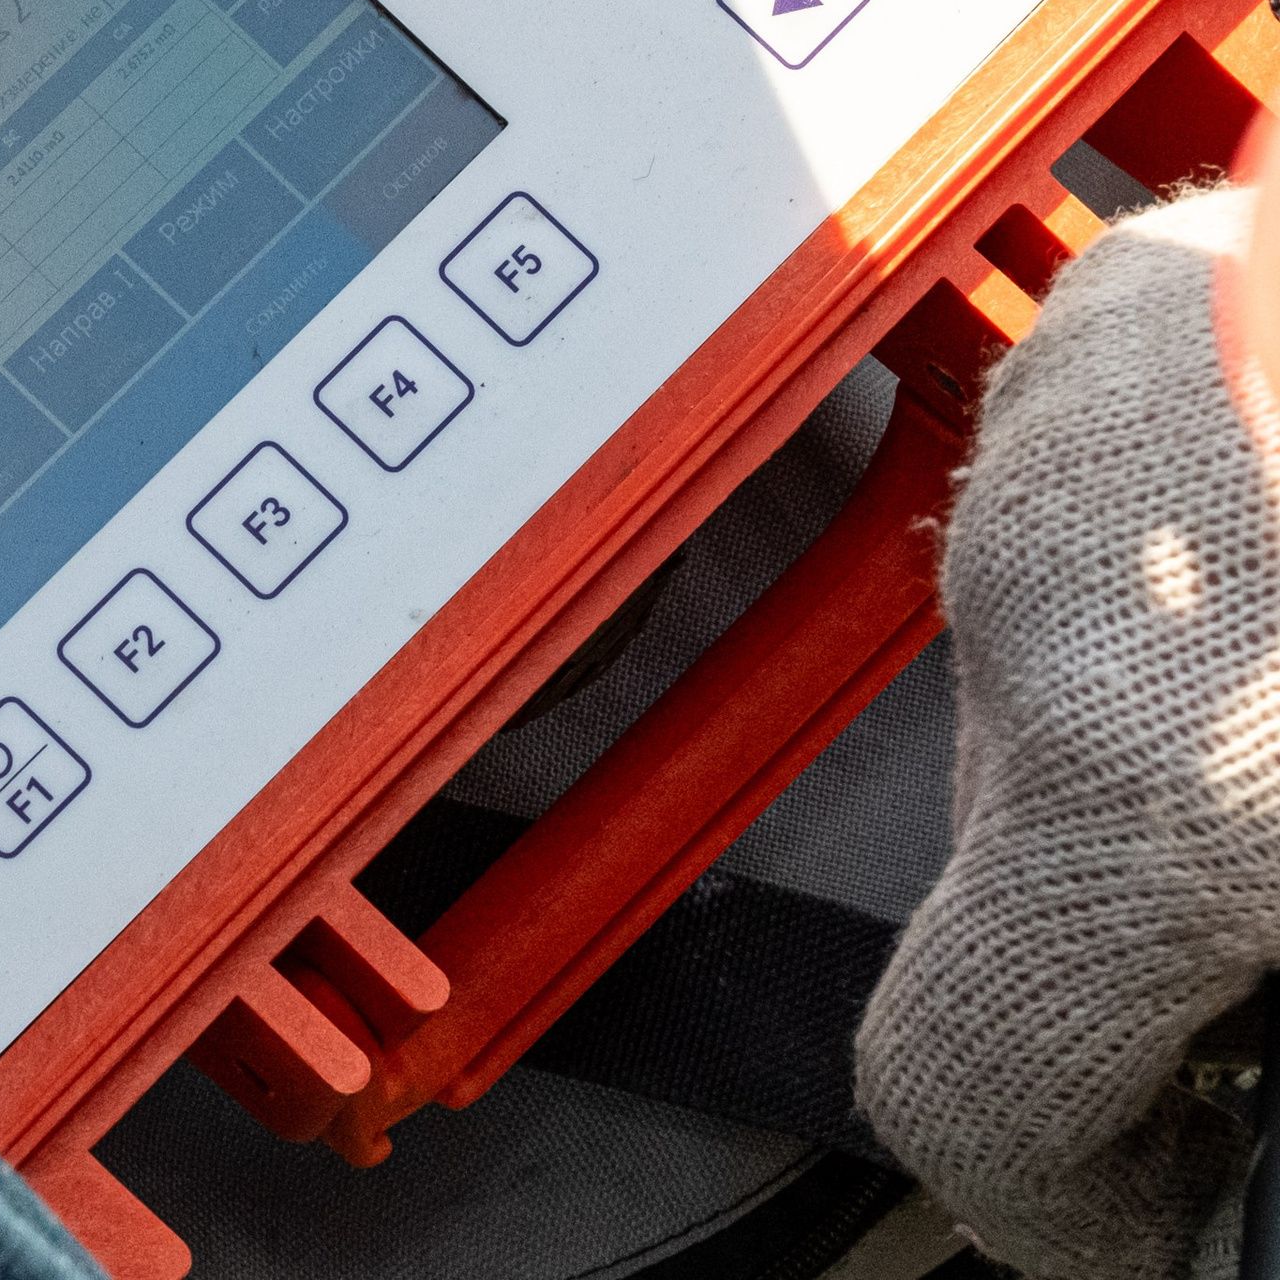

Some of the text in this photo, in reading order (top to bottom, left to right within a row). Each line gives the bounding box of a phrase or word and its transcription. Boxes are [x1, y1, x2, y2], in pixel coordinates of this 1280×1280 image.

[79, 4, 103, 27] не
[262, 22, 390, 148] Настройки
[379, 132, 450, 202] Останов
[155, 164, 241, 247] Режим
[493, 244, 543, 294] F5
[242, 251, 333, 340] Сохранить
[26, 277, 129, 379] Направ.
[368, 369, 418, 419] F4
[241, 497, 291, 546] F3
[113, 624, 166, 674] F2
[5, 776, 54, 825] F1
